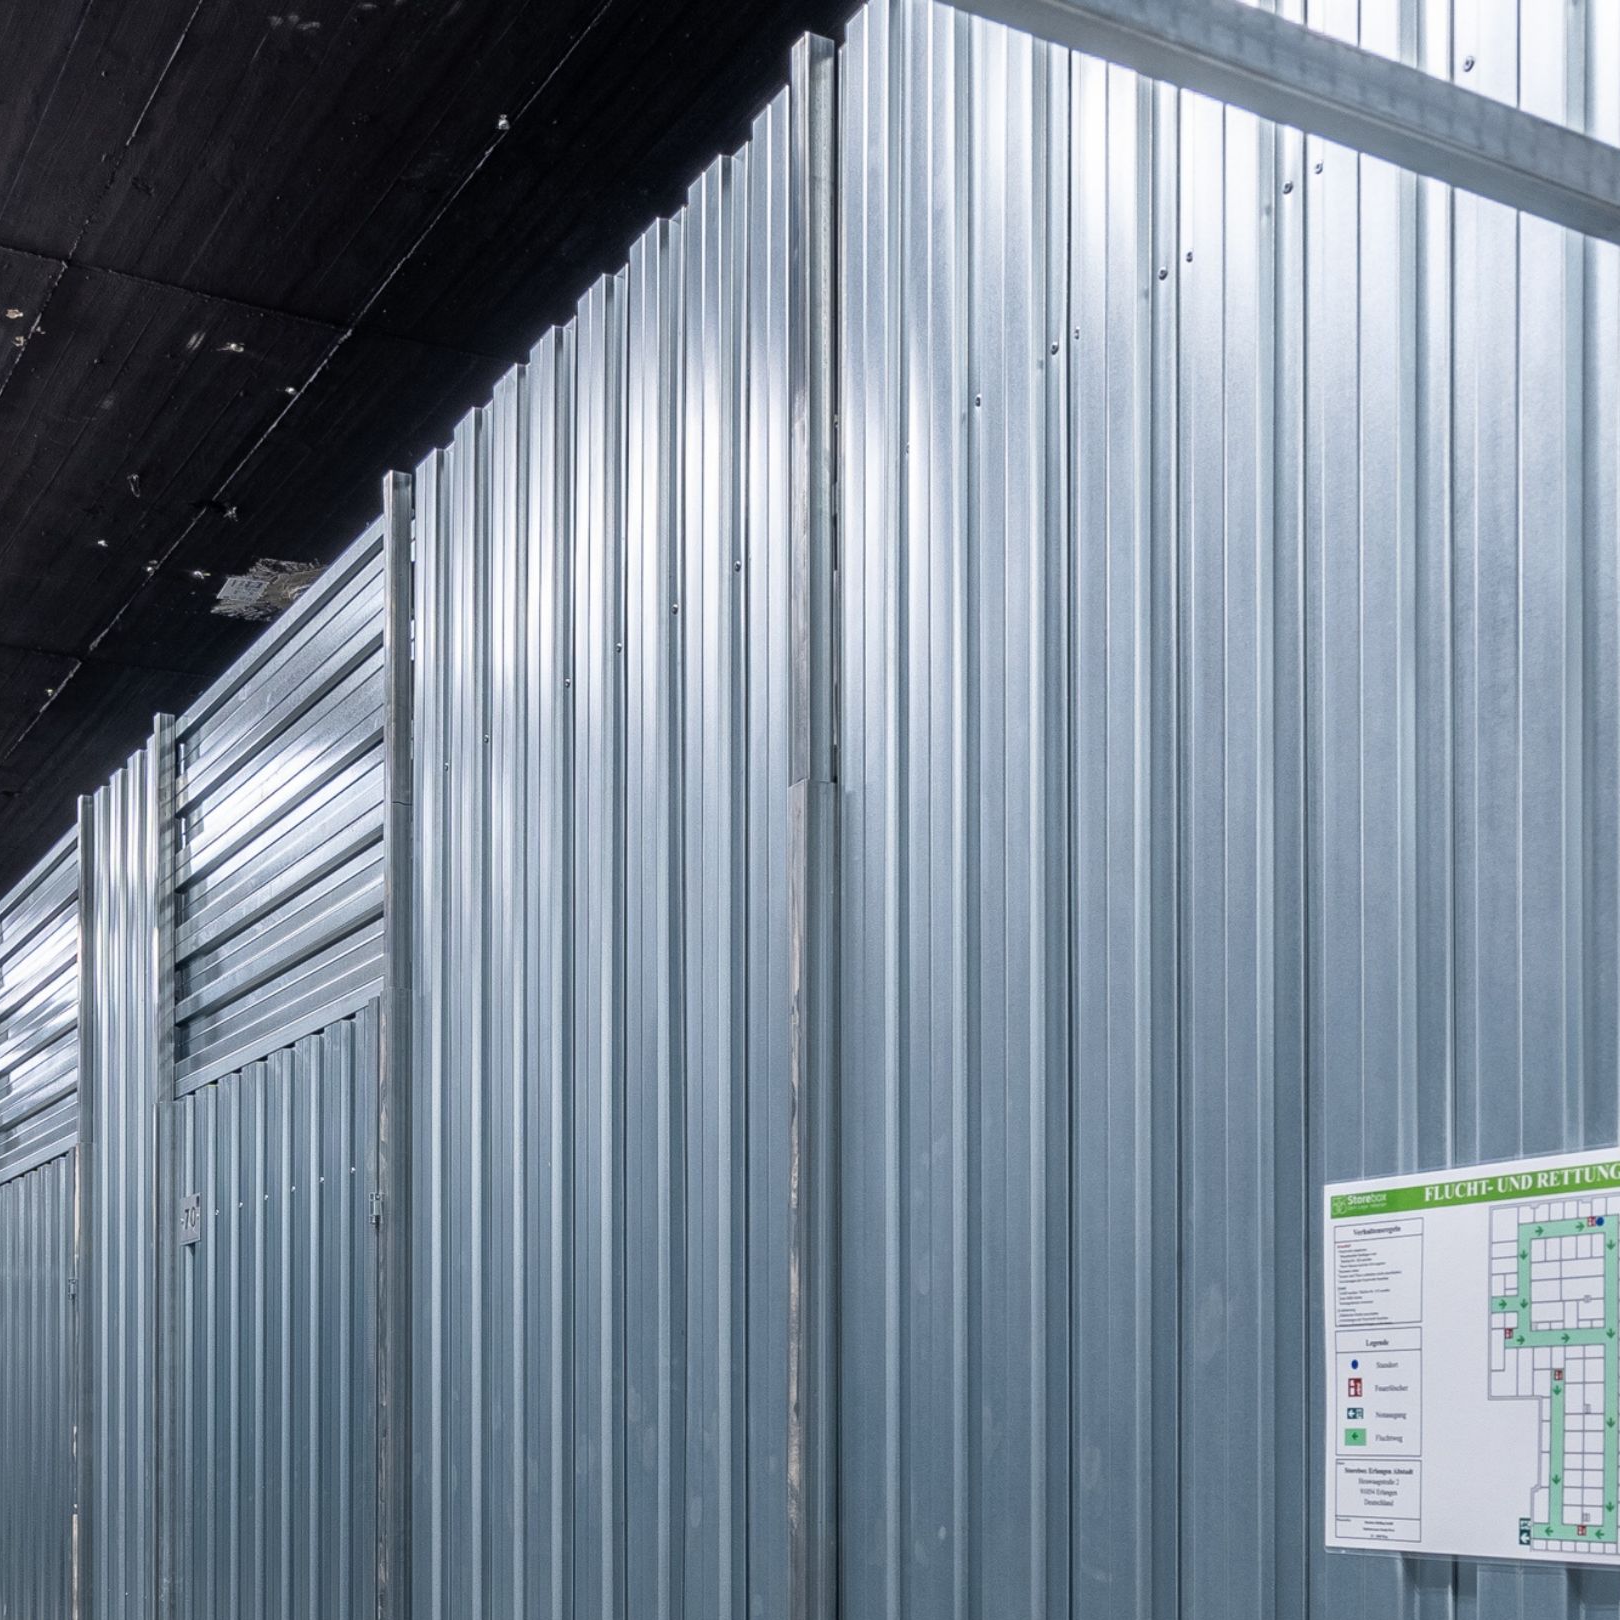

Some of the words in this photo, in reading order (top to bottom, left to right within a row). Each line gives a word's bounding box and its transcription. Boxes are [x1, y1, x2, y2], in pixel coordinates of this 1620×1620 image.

[1347, 1193, 1387, 1205] Storebox
[1424, 1179, 1494, 1202] FLUCHT-
[1497, 1174, 1533, 1194] UND
[185, 1206, 196, 1230] 70
